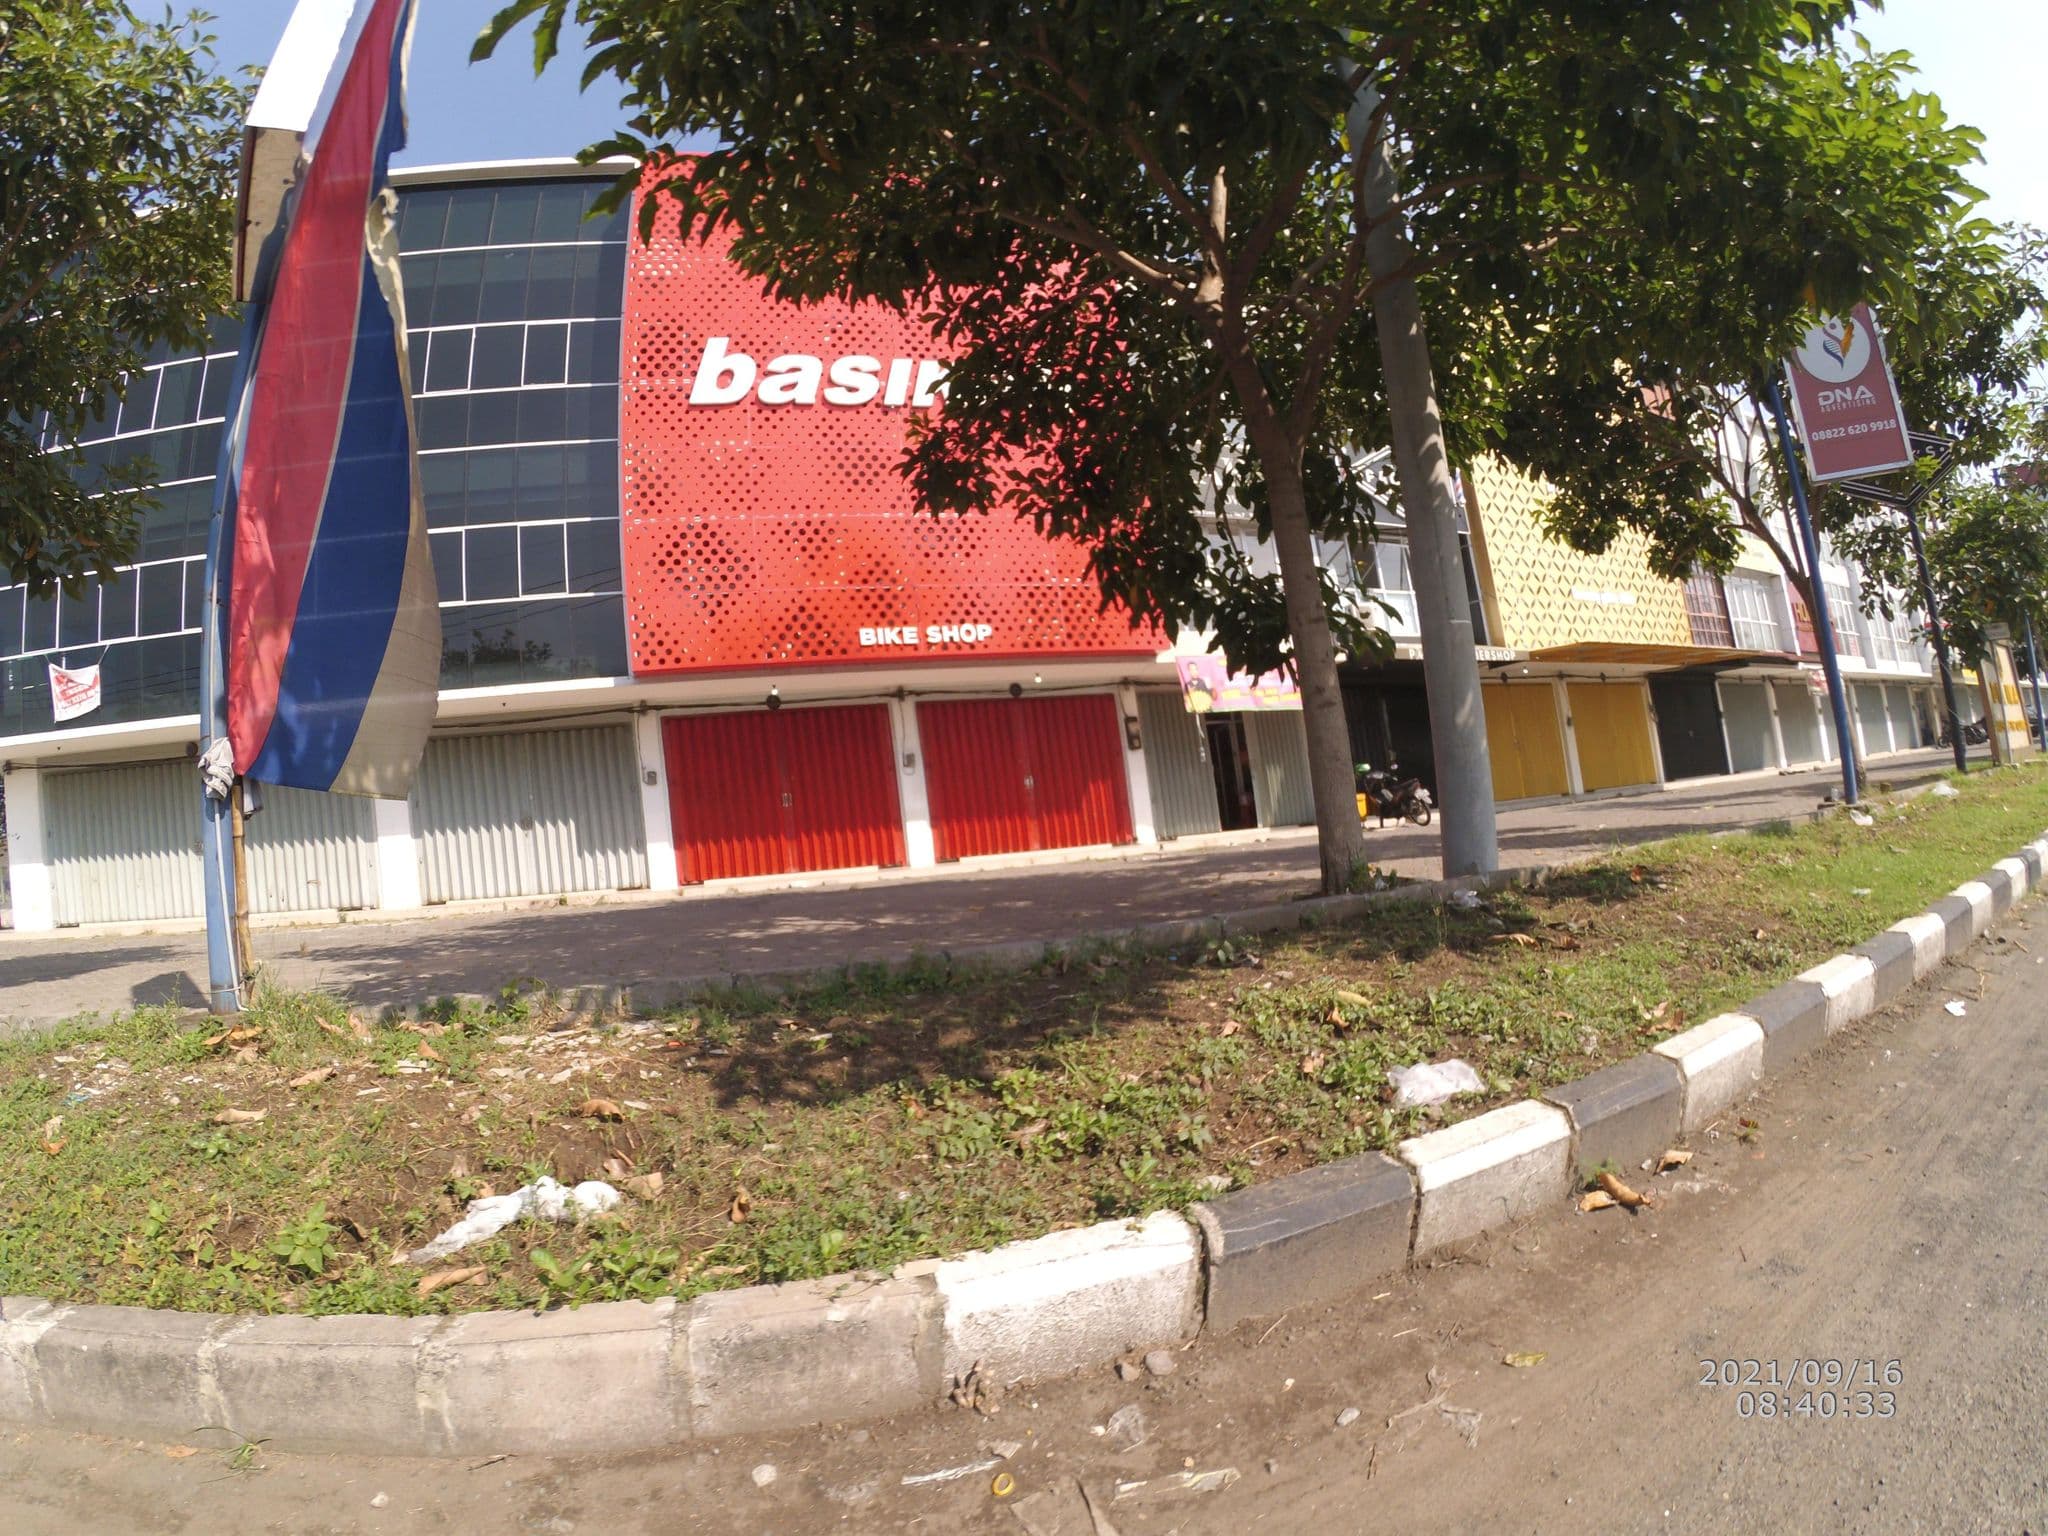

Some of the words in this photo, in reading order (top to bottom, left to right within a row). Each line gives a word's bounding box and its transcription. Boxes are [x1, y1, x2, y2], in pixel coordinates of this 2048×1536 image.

[1817, 385, 1874, 406] DNA
[1811, 428, 1846, 441] 08822
[1848, 423, 1868, 434] 620
[1870, 419, 1897, 432] 9918
[858, 626, 919, 646] BIKE
[926, 623, 993, 645] SHOP
